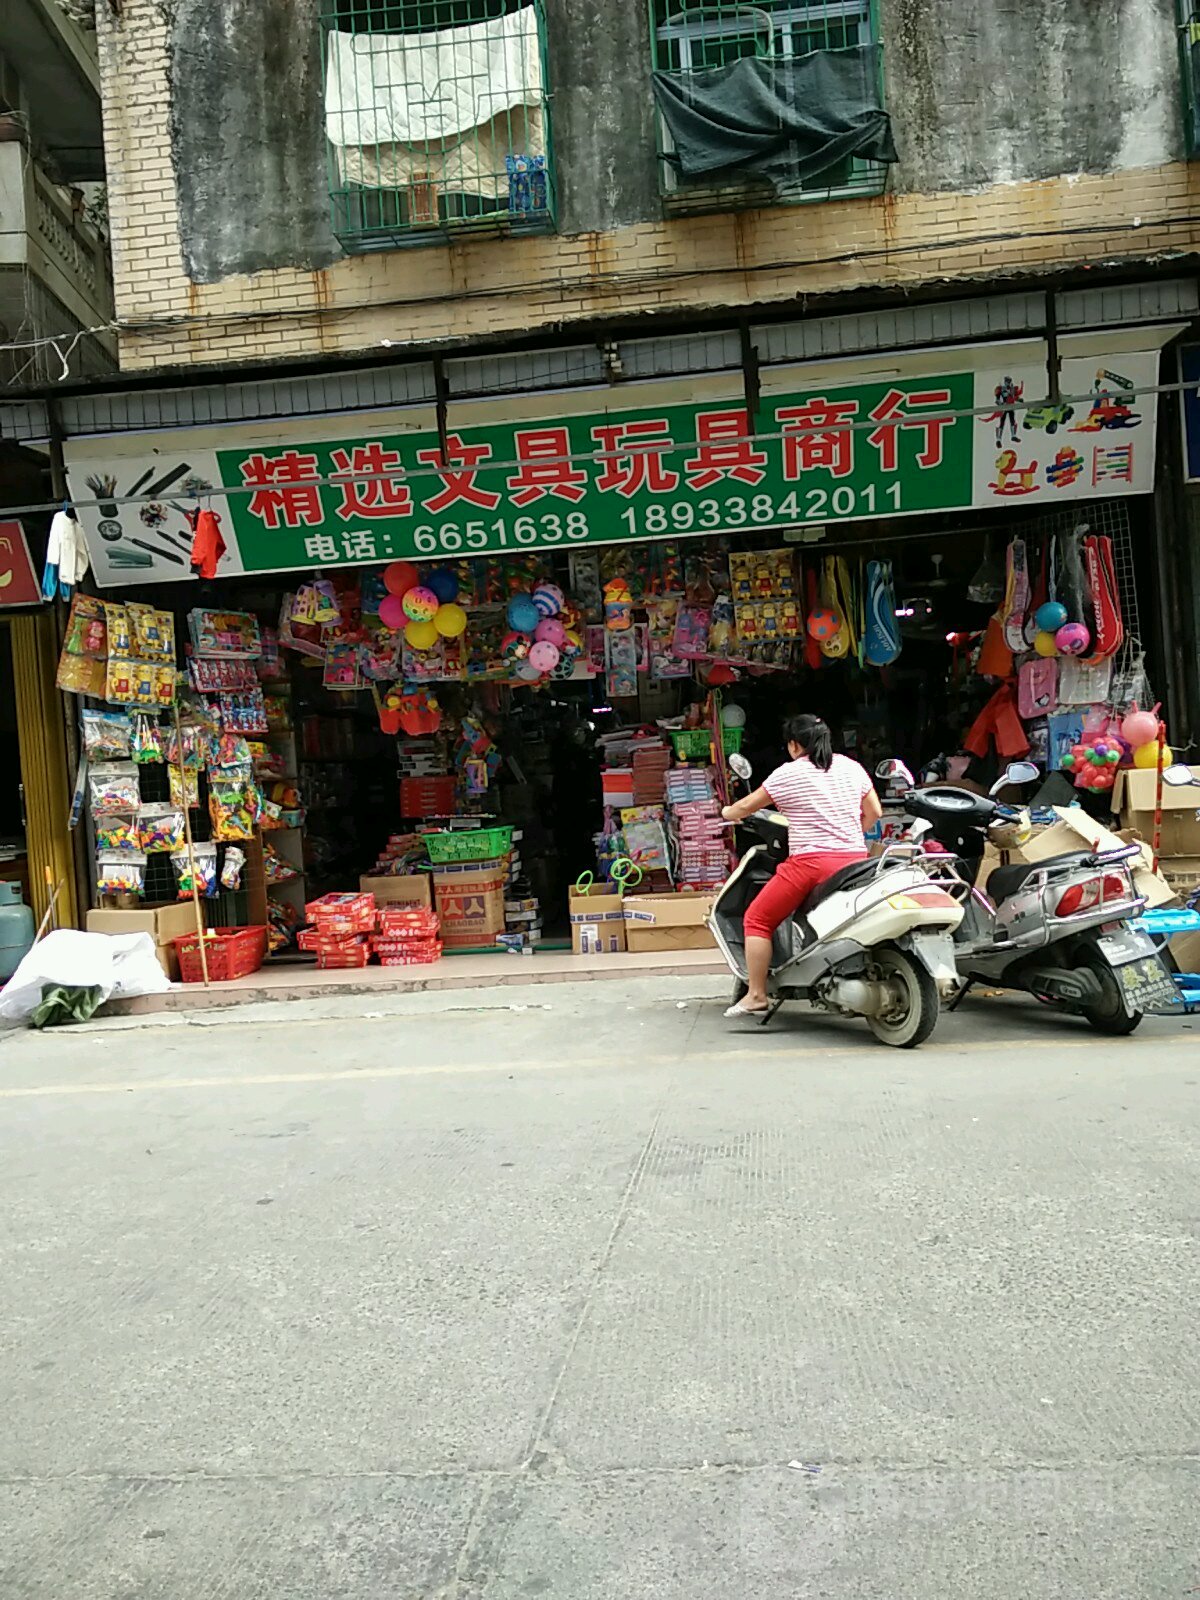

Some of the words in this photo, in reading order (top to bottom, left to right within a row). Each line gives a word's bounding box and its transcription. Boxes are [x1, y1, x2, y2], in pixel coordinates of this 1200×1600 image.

[239, 389, 957, 530] 精选文具玩具商行
[413, 511, 590, 553] 6651638
[620, 480, 902, 535] 18933842011
